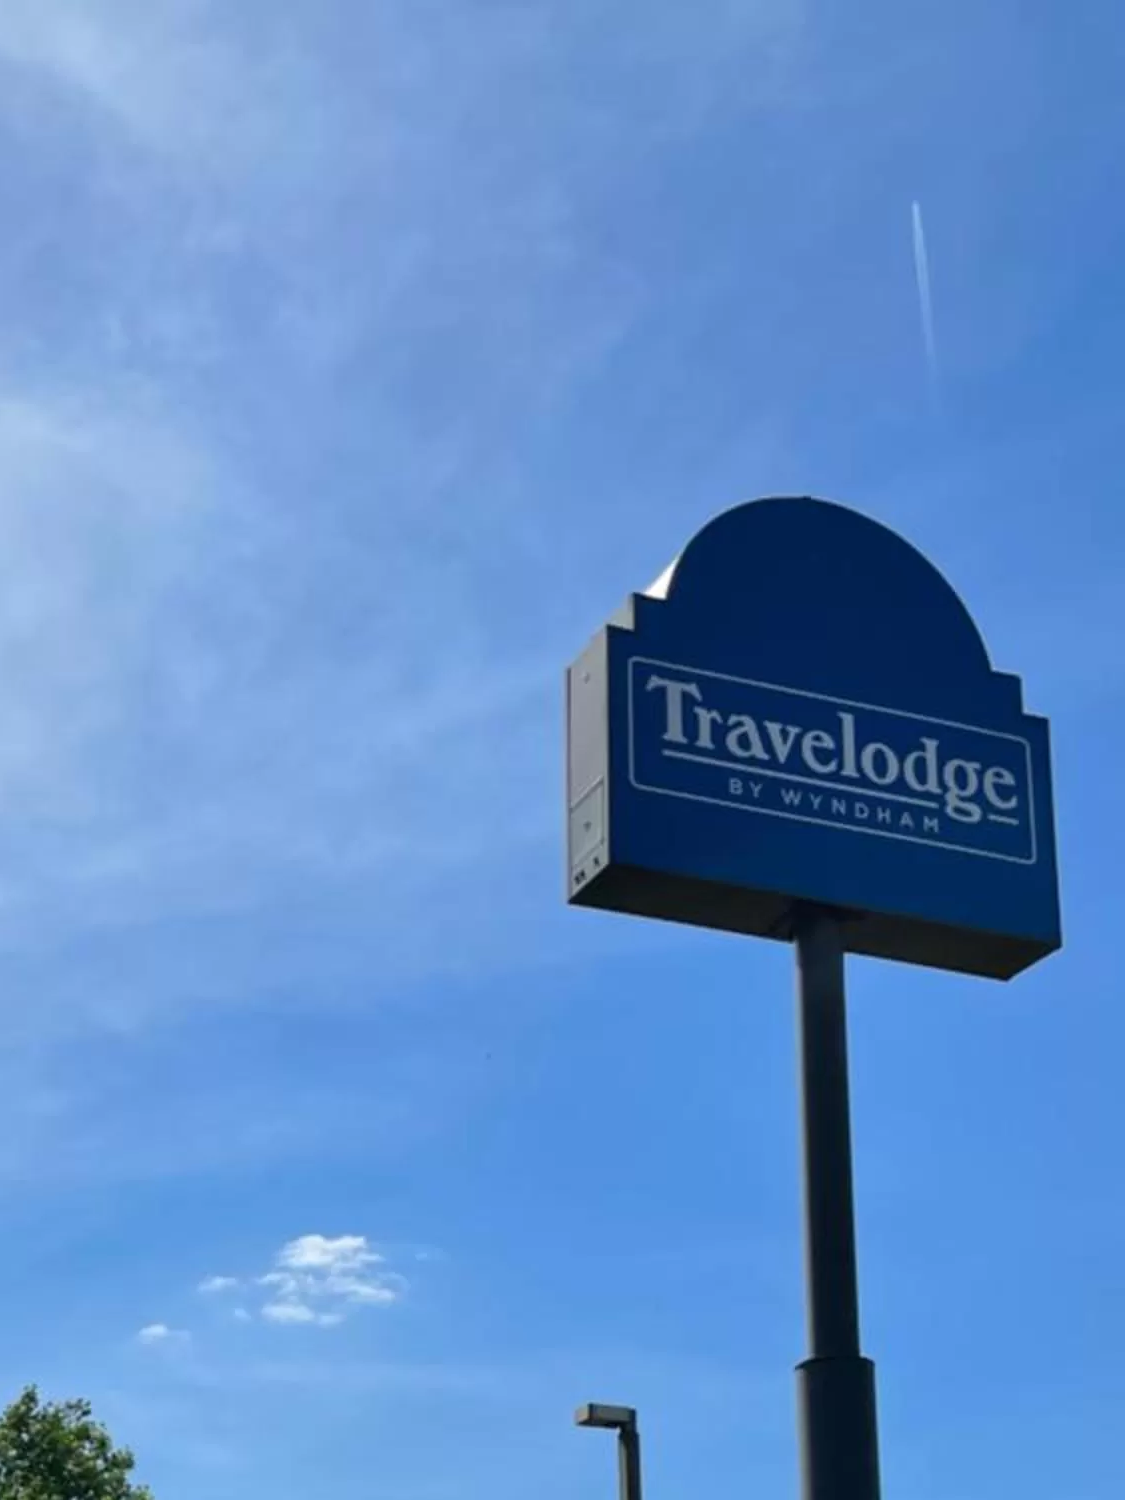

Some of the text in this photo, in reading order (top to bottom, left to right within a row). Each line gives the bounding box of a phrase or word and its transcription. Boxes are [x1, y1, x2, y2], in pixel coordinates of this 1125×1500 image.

[646, 675, 1018, 824] Travelodge
[729, 777, 940, 833] BY WYNDHAM
